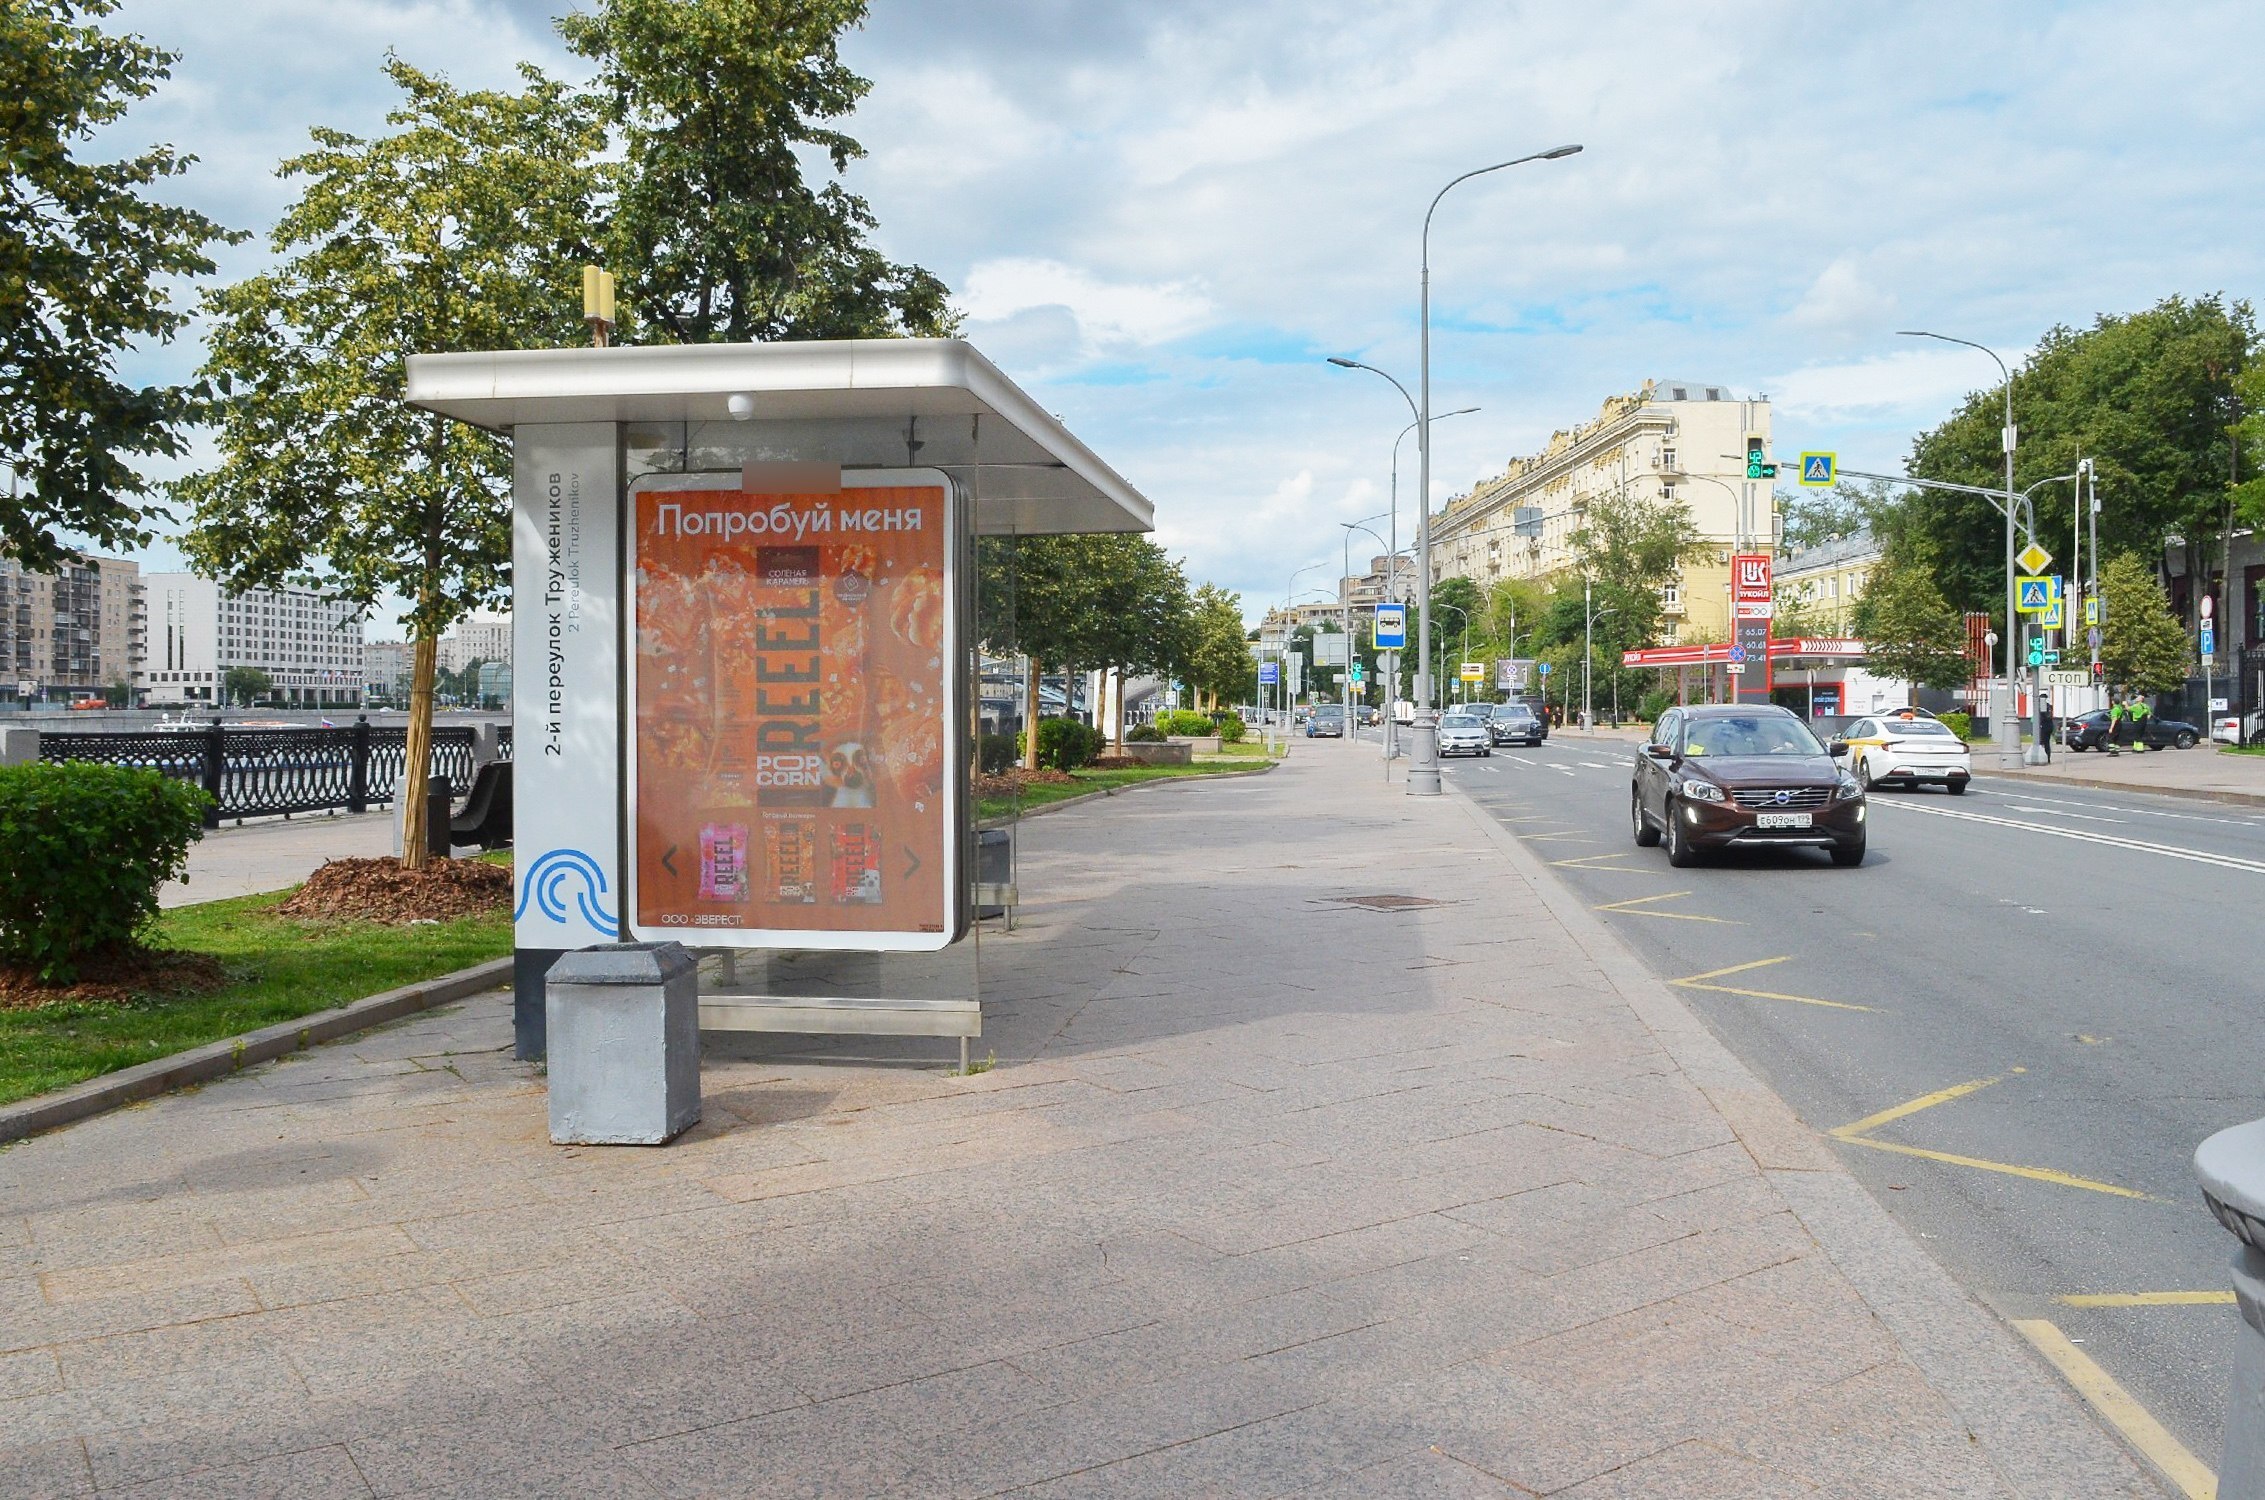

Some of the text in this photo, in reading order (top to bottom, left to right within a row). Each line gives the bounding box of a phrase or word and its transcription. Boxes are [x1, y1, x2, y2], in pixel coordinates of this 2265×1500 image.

[658, 502, 922, 542] Попробуй меня
[568, 473, 580, 632] 2 Pereulok Truzhenikov
[766, 577, 810, 586] КАРАМЕЛЬ
[545, 472, 565, 756] 2-й переулок Тружеников
[2029, 637, 2043, 650] 42
[756, 590, 821, 752] REEEL
[2048, 673, 2081, 684] СТОП
[756, 755, 821, 770] POP
[756, 771, 821, 786] CORN
[714, 837, 734, 885] REEEL
[661, 914, 689, 924] ООО
